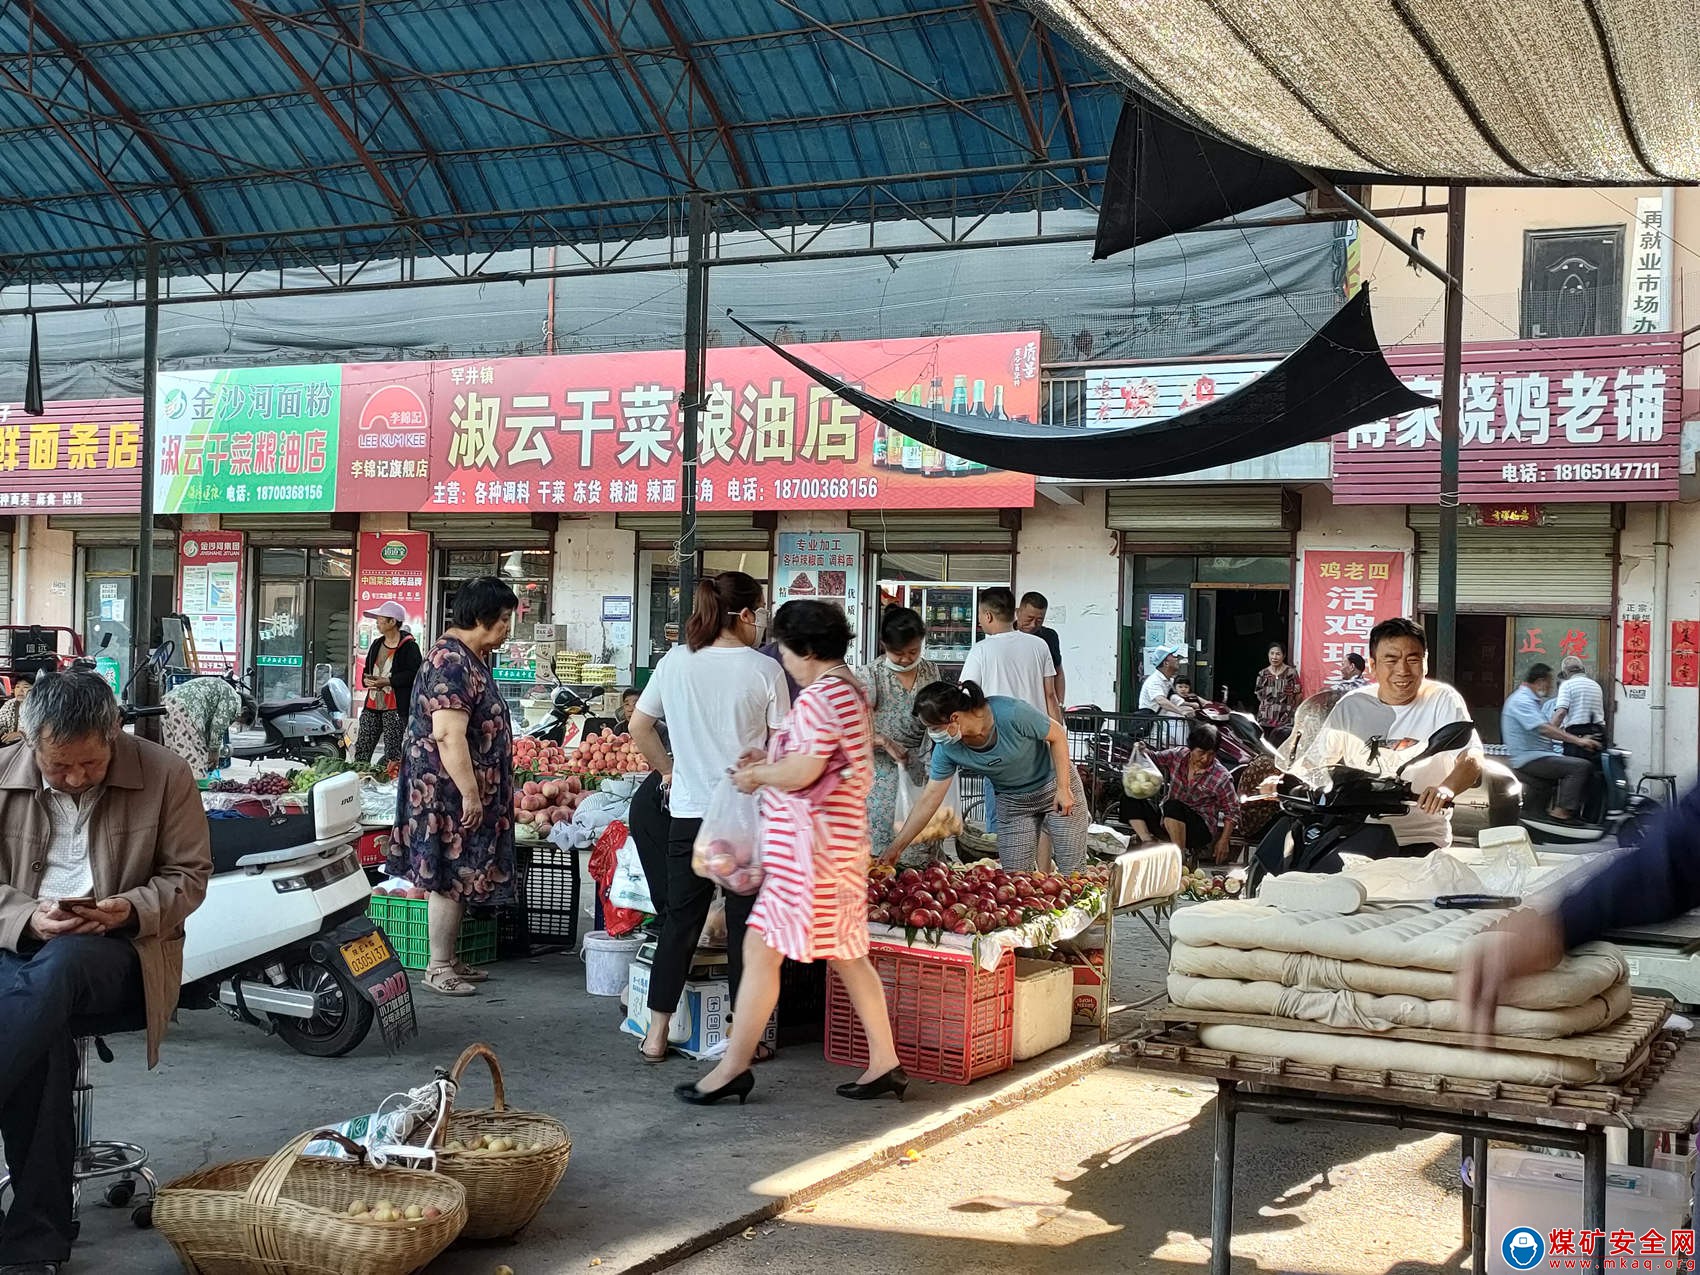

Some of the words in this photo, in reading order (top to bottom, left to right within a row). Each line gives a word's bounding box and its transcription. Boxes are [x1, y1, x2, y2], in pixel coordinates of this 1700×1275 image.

[451, 367, 494, 385] 罕井镇
[191, 380, 334, 421] 金沙河面粉
[358, 433, 378, 448] LEE
[379, 433, 404, 447] KUM
[405, 432, 427, 447] KEE
[160, 430, 327, 476] 淑云干菜粮油店
[351, 459, 429, 478] 李锦记旗舰店
[538, 480, 566, 505] 干菜
[573, 480, 601, 504] 冻货
[609, 479, 638, 503] 粮油
[797, 539, 842, 551] 专业加工
[784, 554, 825, 567] 各种辣椒面
[830, 554, 854, 567] 调料面
[1319, 562, 1389, 580] 鸡老四
[351, 945, 387, 972] 0305137
